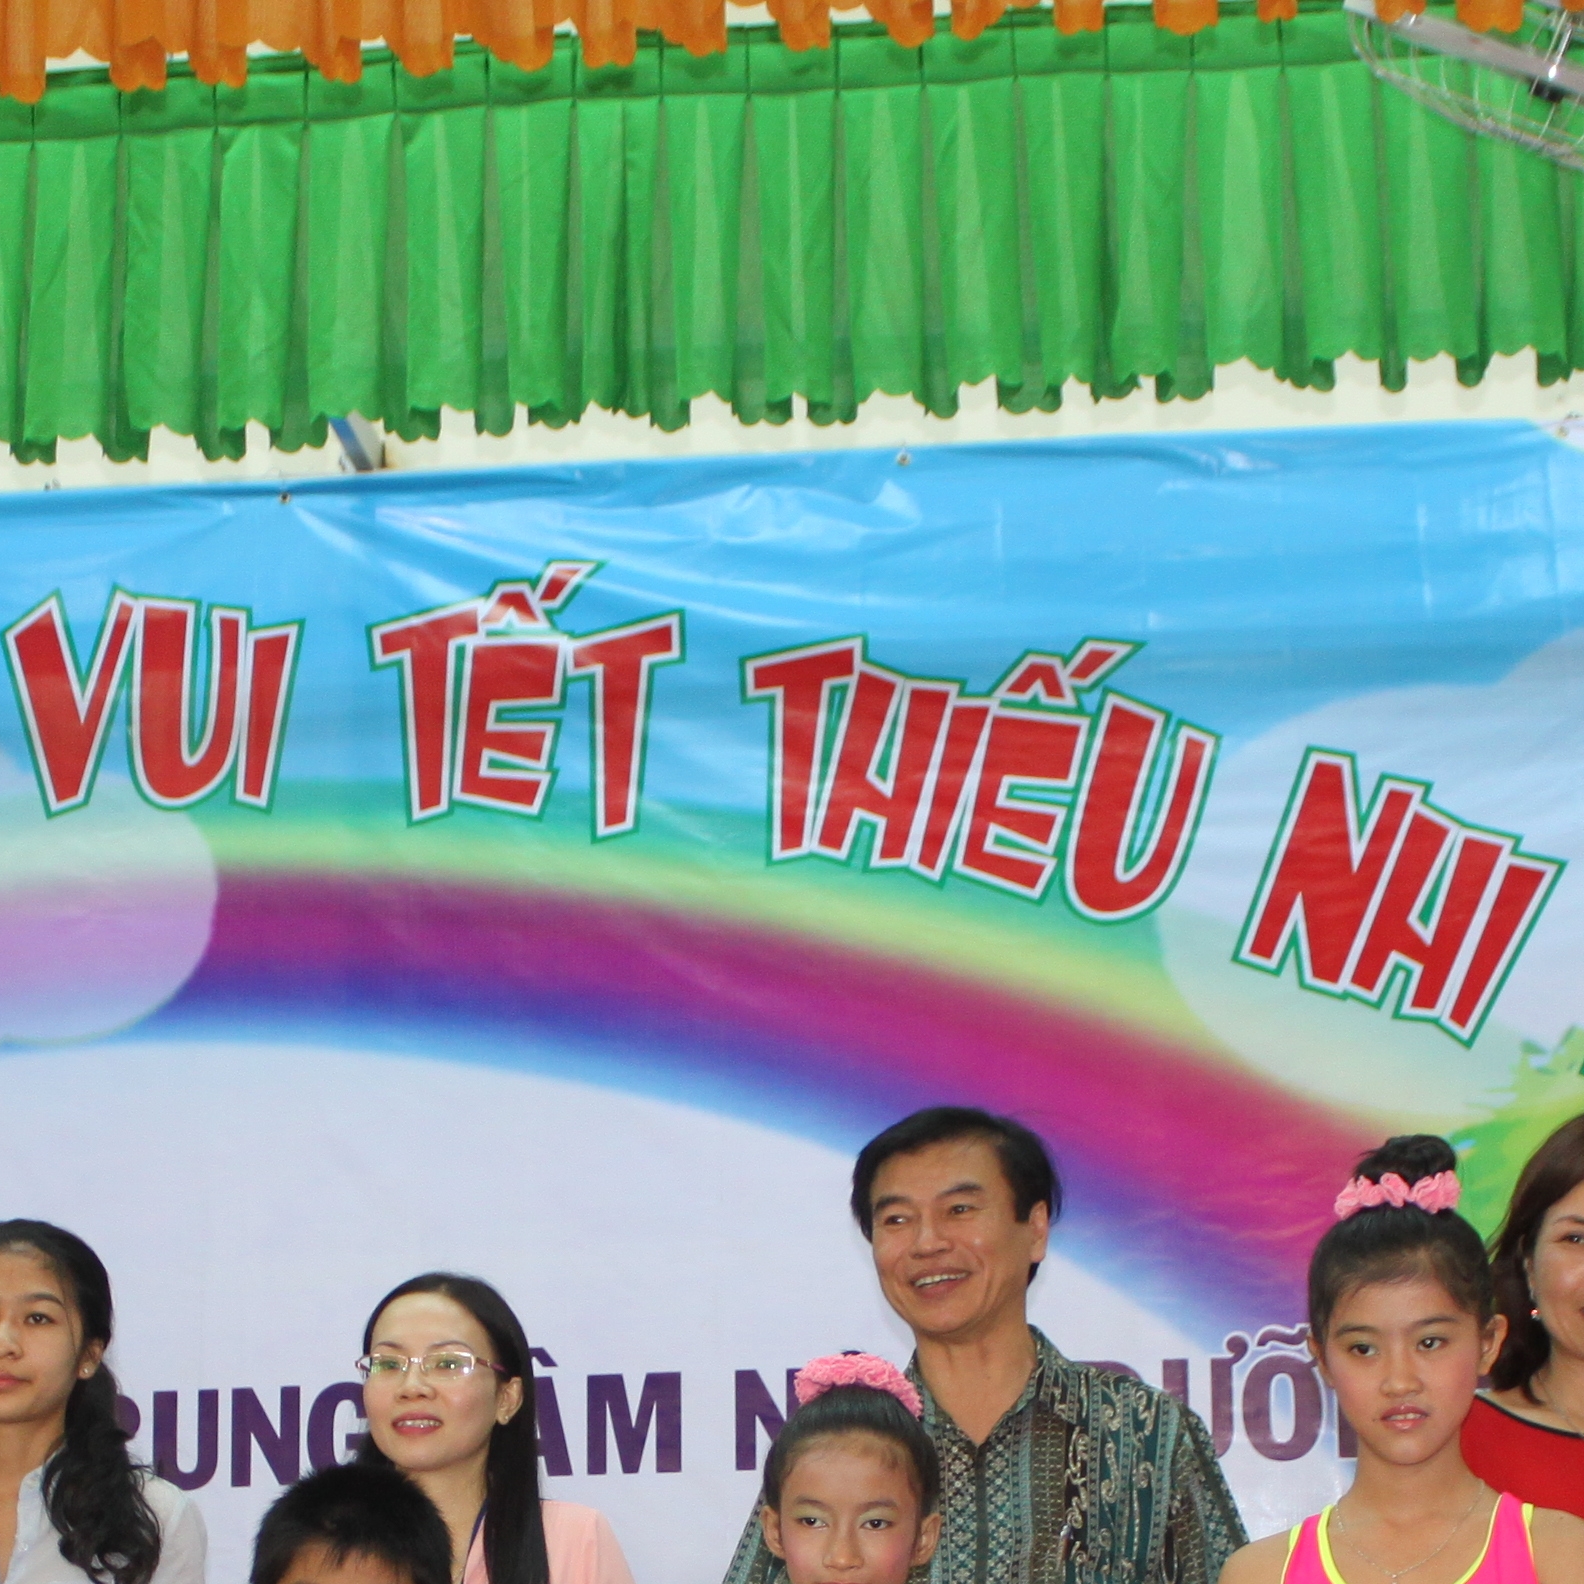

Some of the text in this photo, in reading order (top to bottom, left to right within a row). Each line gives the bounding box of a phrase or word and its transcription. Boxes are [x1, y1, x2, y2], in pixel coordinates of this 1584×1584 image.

[0, 583, 305, 816] VUI
[367, 558, 686, 842] TẾT
[739, 634, 1223, 924] THIẾU
[1231, 746, 1568, 1048] NHI
